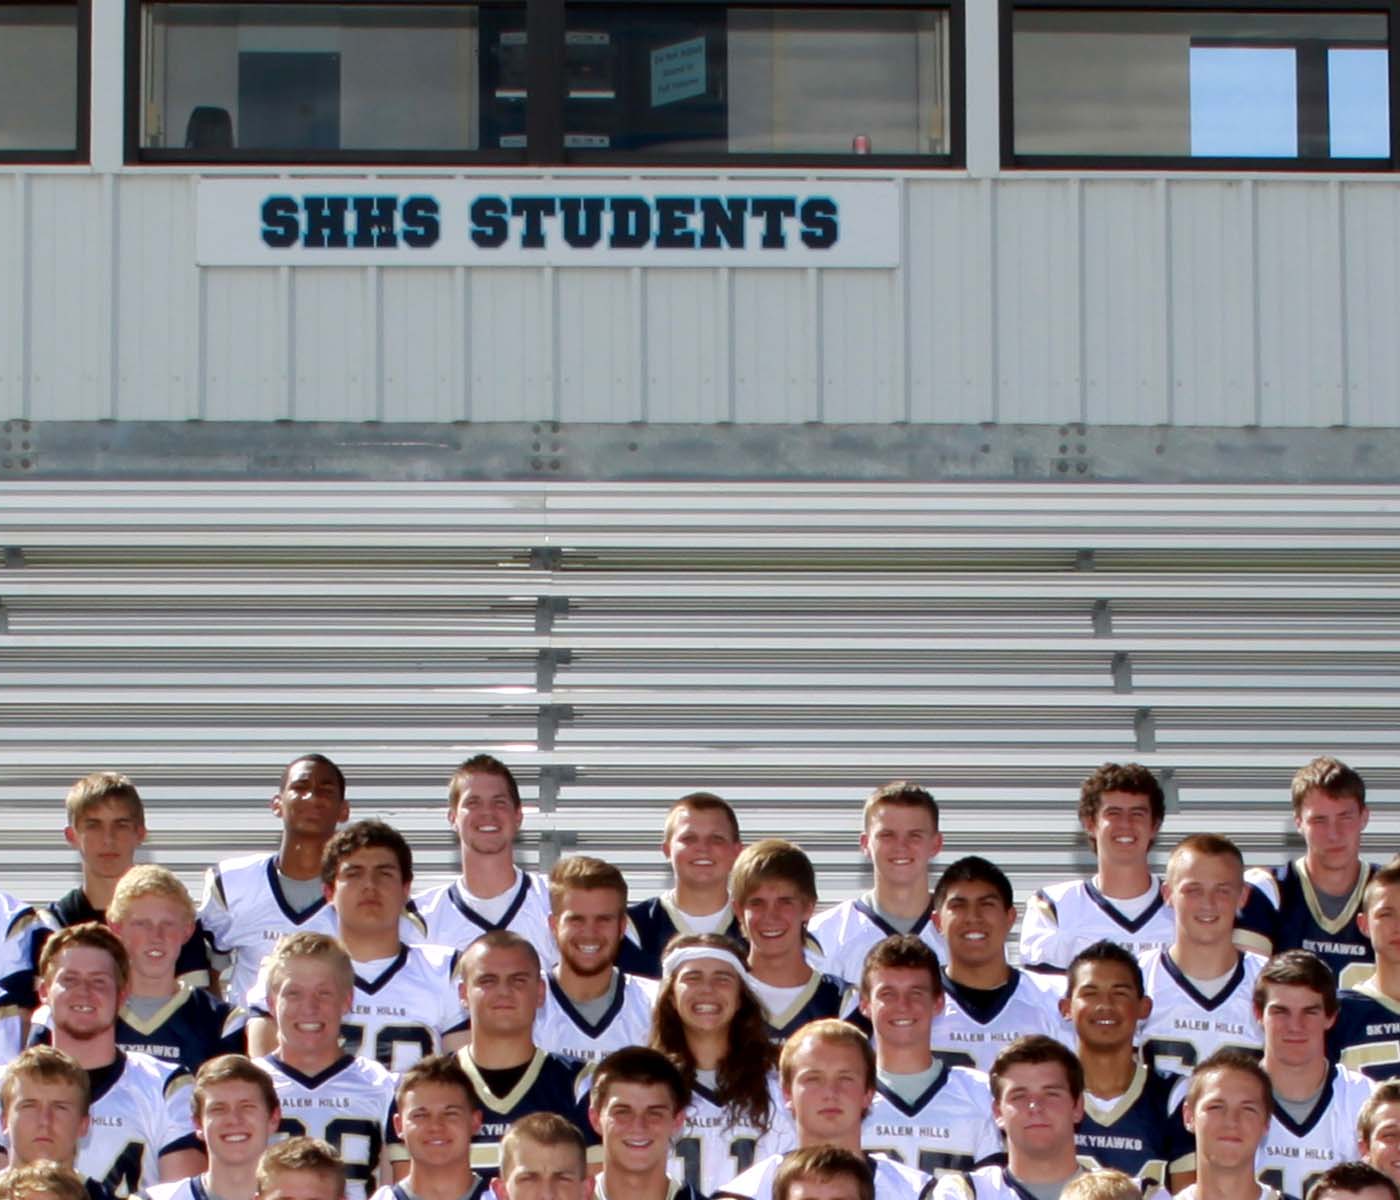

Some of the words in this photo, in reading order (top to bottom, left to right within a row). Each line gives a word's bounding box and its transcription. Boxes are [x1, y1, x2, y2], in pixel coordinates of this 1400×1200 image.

[260, 195, 440, 250] SHHS
[469, 195, 840, 250] STUDENTS
[1174, 1019, 1209, 1032] SALEM
[1215, 1021, 1244, 1035] HILLS
[91, 1116, 123, 1127] HILLS
[875, 1125, 913, 1137] SALEM
[919, 1127, 950, 1139] HILLS
[1266, 1146, 1299, 1159] SALEM
[1304, 1148, 1334, 1161] HILLS
